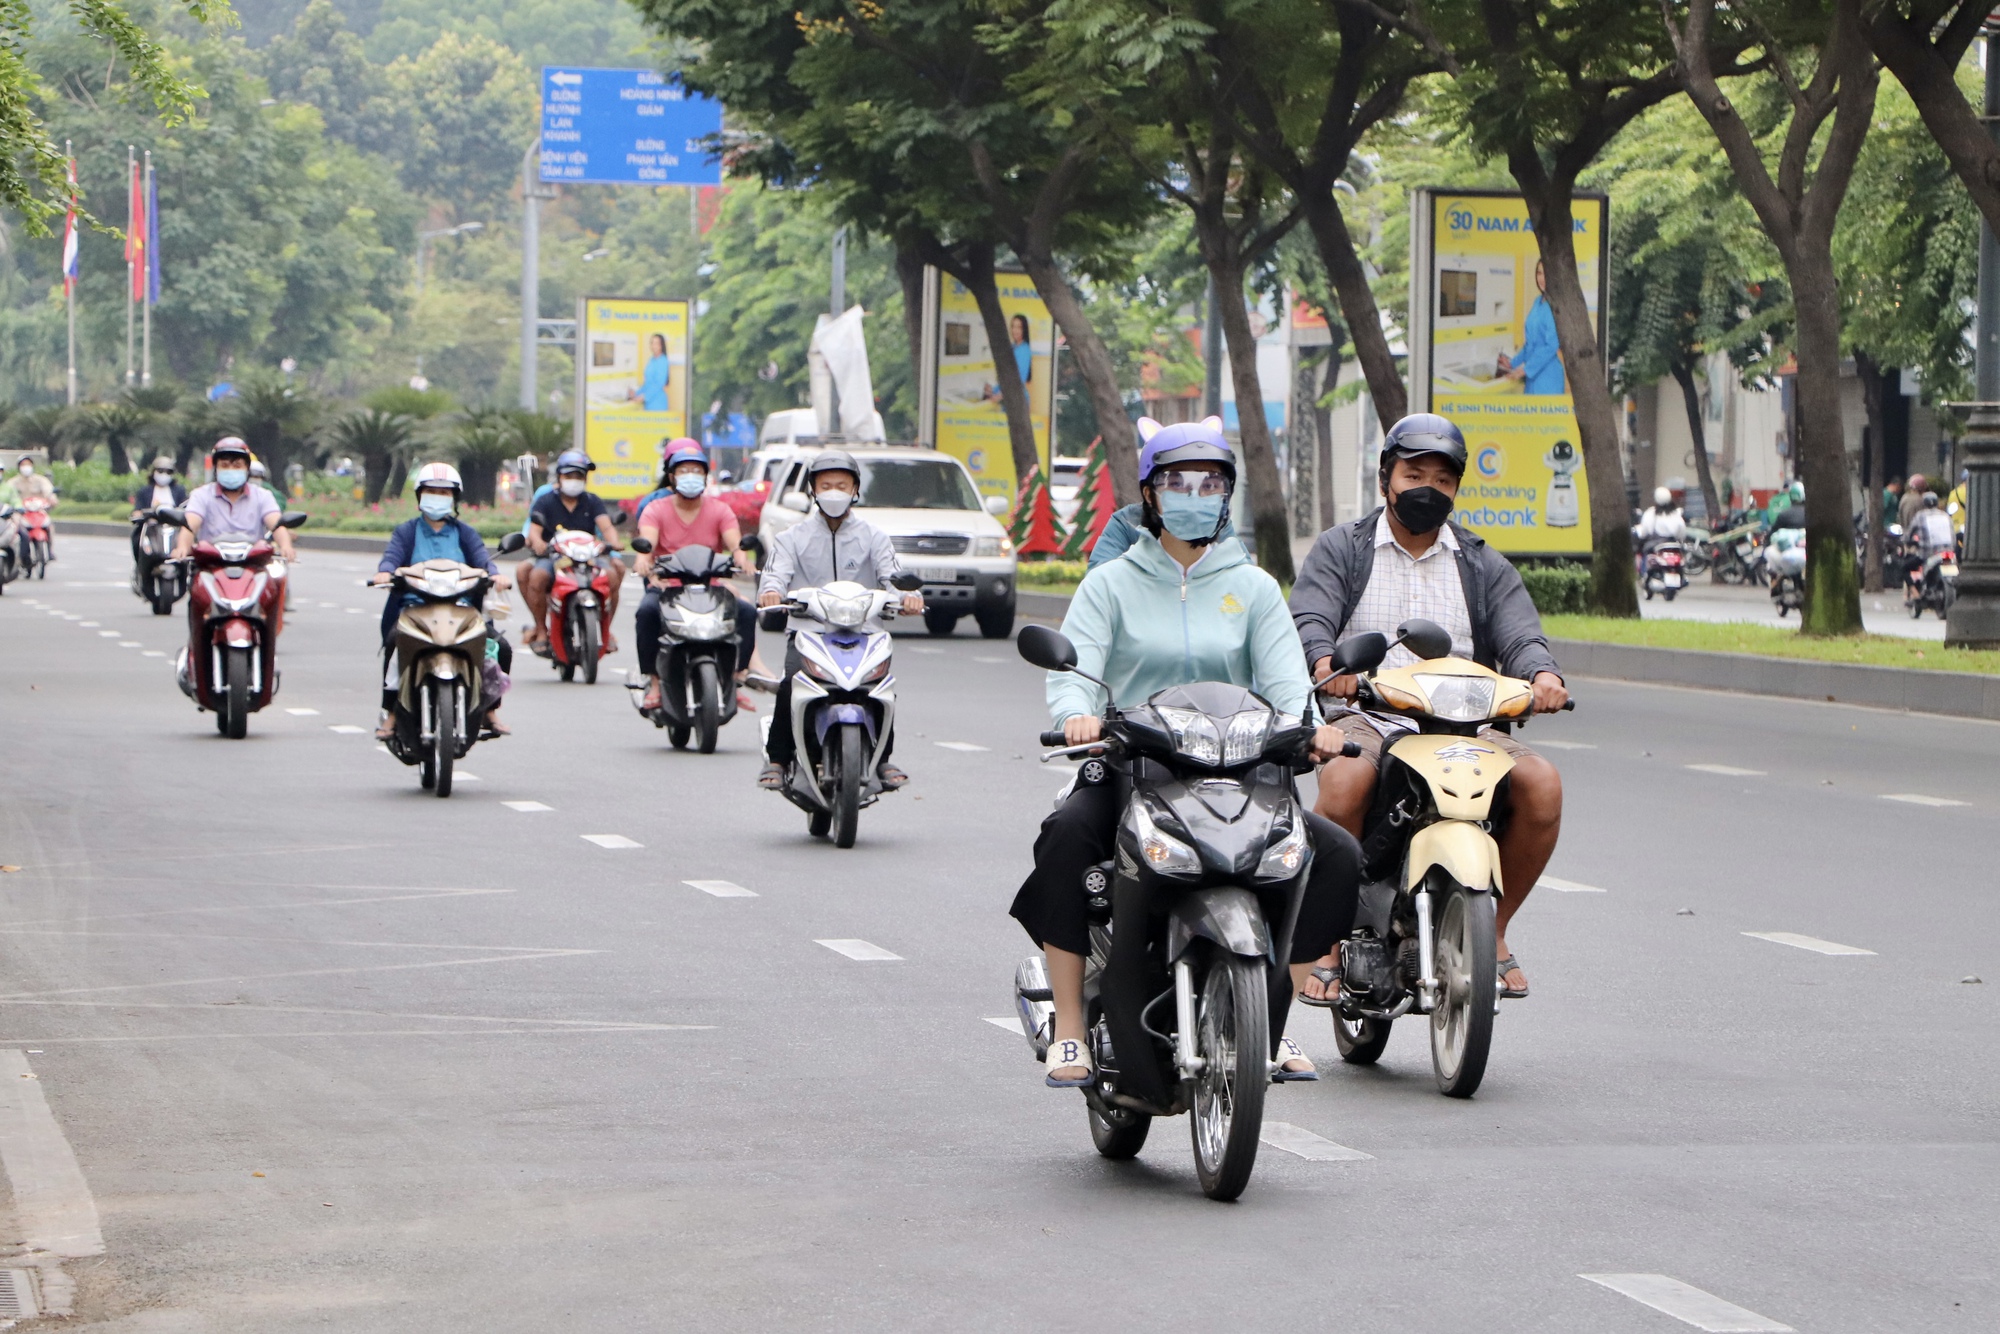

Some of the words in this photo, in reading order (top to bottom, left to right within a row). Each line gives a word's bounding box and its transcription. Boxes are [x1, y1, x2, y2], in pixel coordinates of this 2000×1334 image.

[637, 73, 664, 85] ĐƯỜN
[656, 90, 683, 101] MINH
[550, 117, 573, 128] LAN
[565, 167, 585, 177] ANH
[1450, 211, 1472, 230] 30
[1477, 218, 1519, 232] NAM
[1013, 288, 1041, 299] BAN
[1481, 485, 1536, 501] banking
[1061, 1041, 1078, 1063] B
